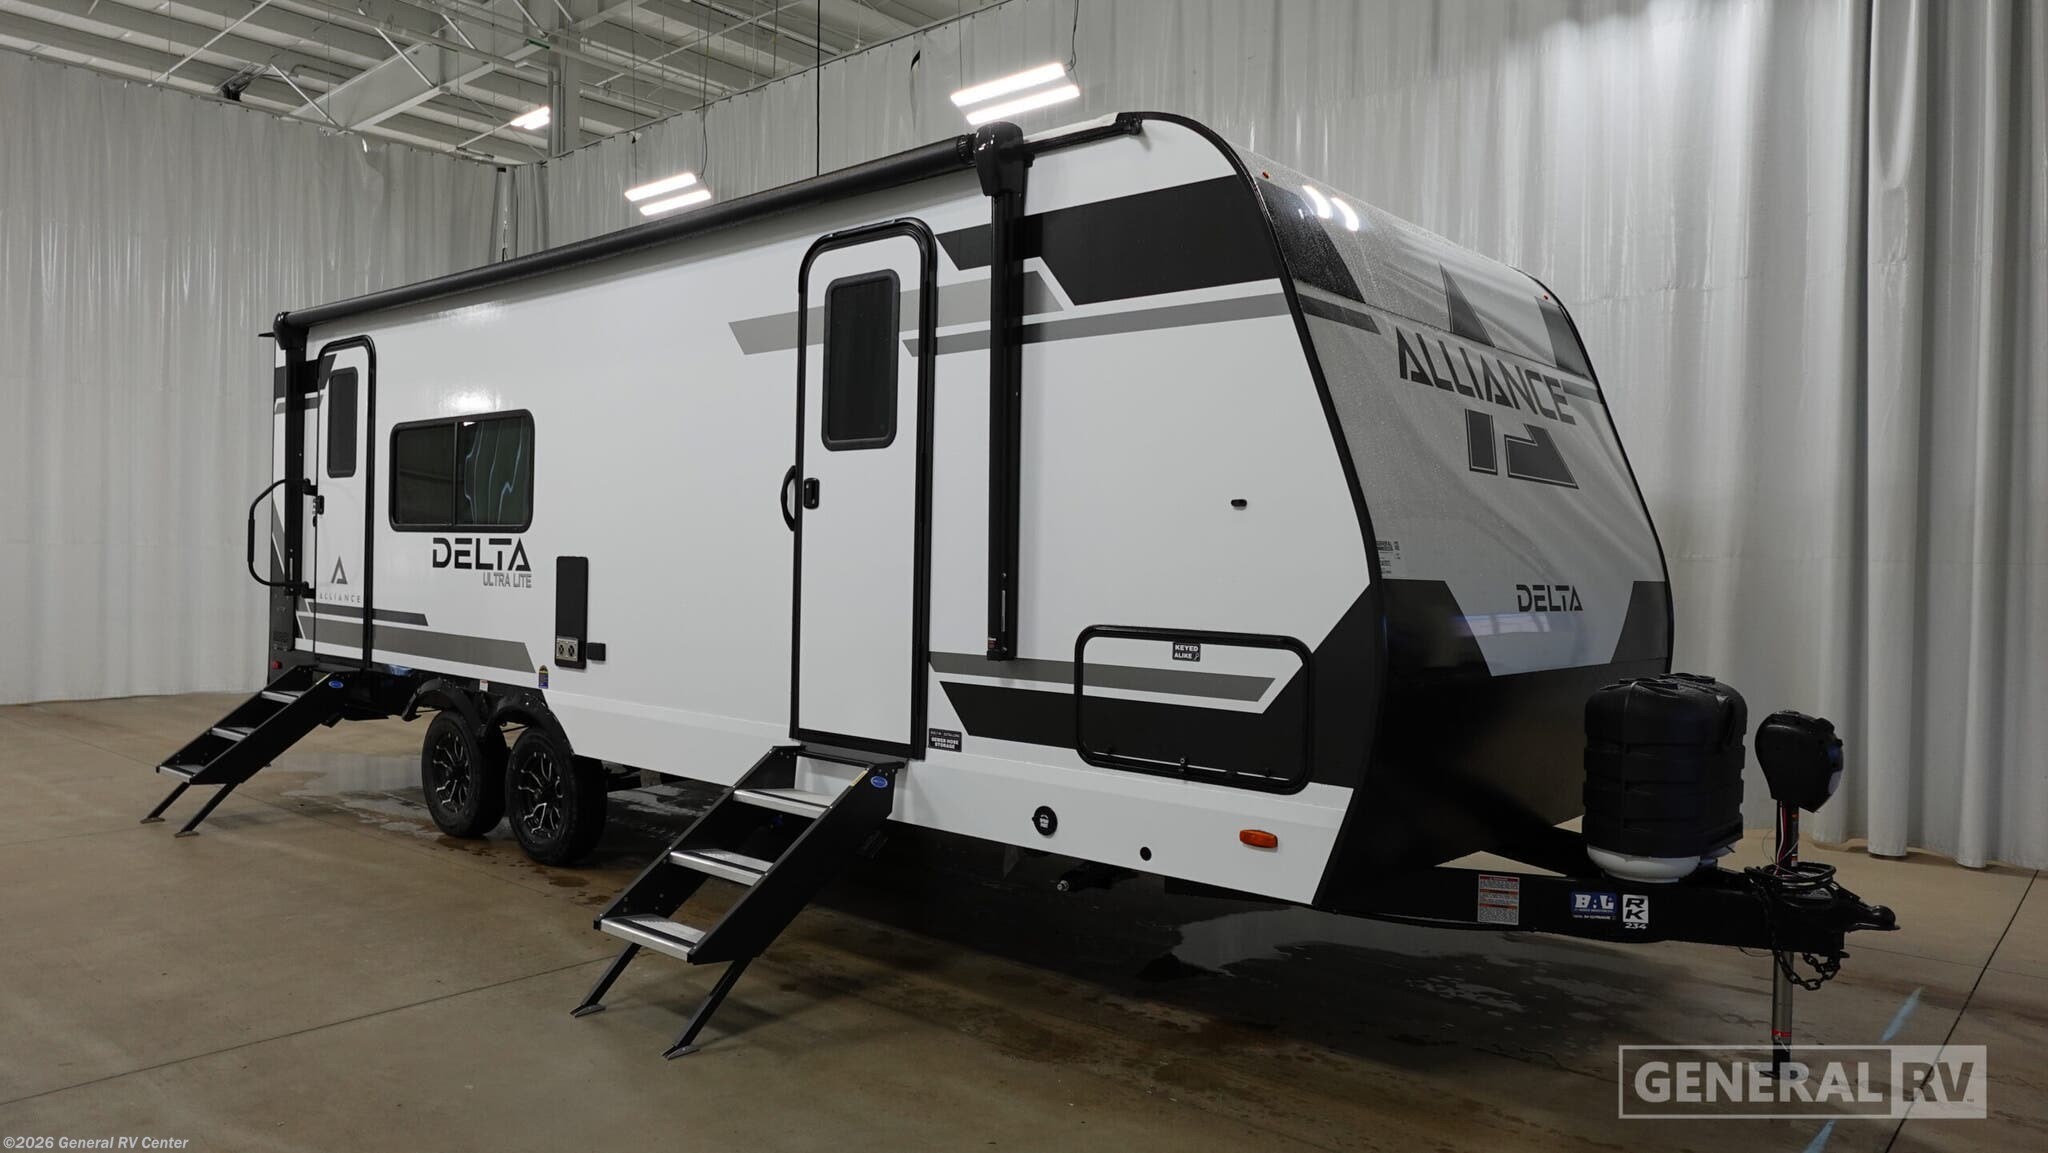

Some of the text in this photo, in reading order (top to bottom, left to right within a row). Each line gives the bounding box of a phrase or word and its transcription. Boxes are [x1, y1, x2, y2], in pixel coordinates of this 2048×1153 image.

[1396, 326, 1577, 426] ALLIANCE
[432, 536, 532, 572] DELTA
[483, 572, 532, 589] ULTRA LITE
[319, 592, 361, 604] ALLIANCE
[1516, 583, 1584, 613] DELTA
[1173, 652, 1193, 660] ALIKE
[1174, 644, 1199, 652] KEYED
